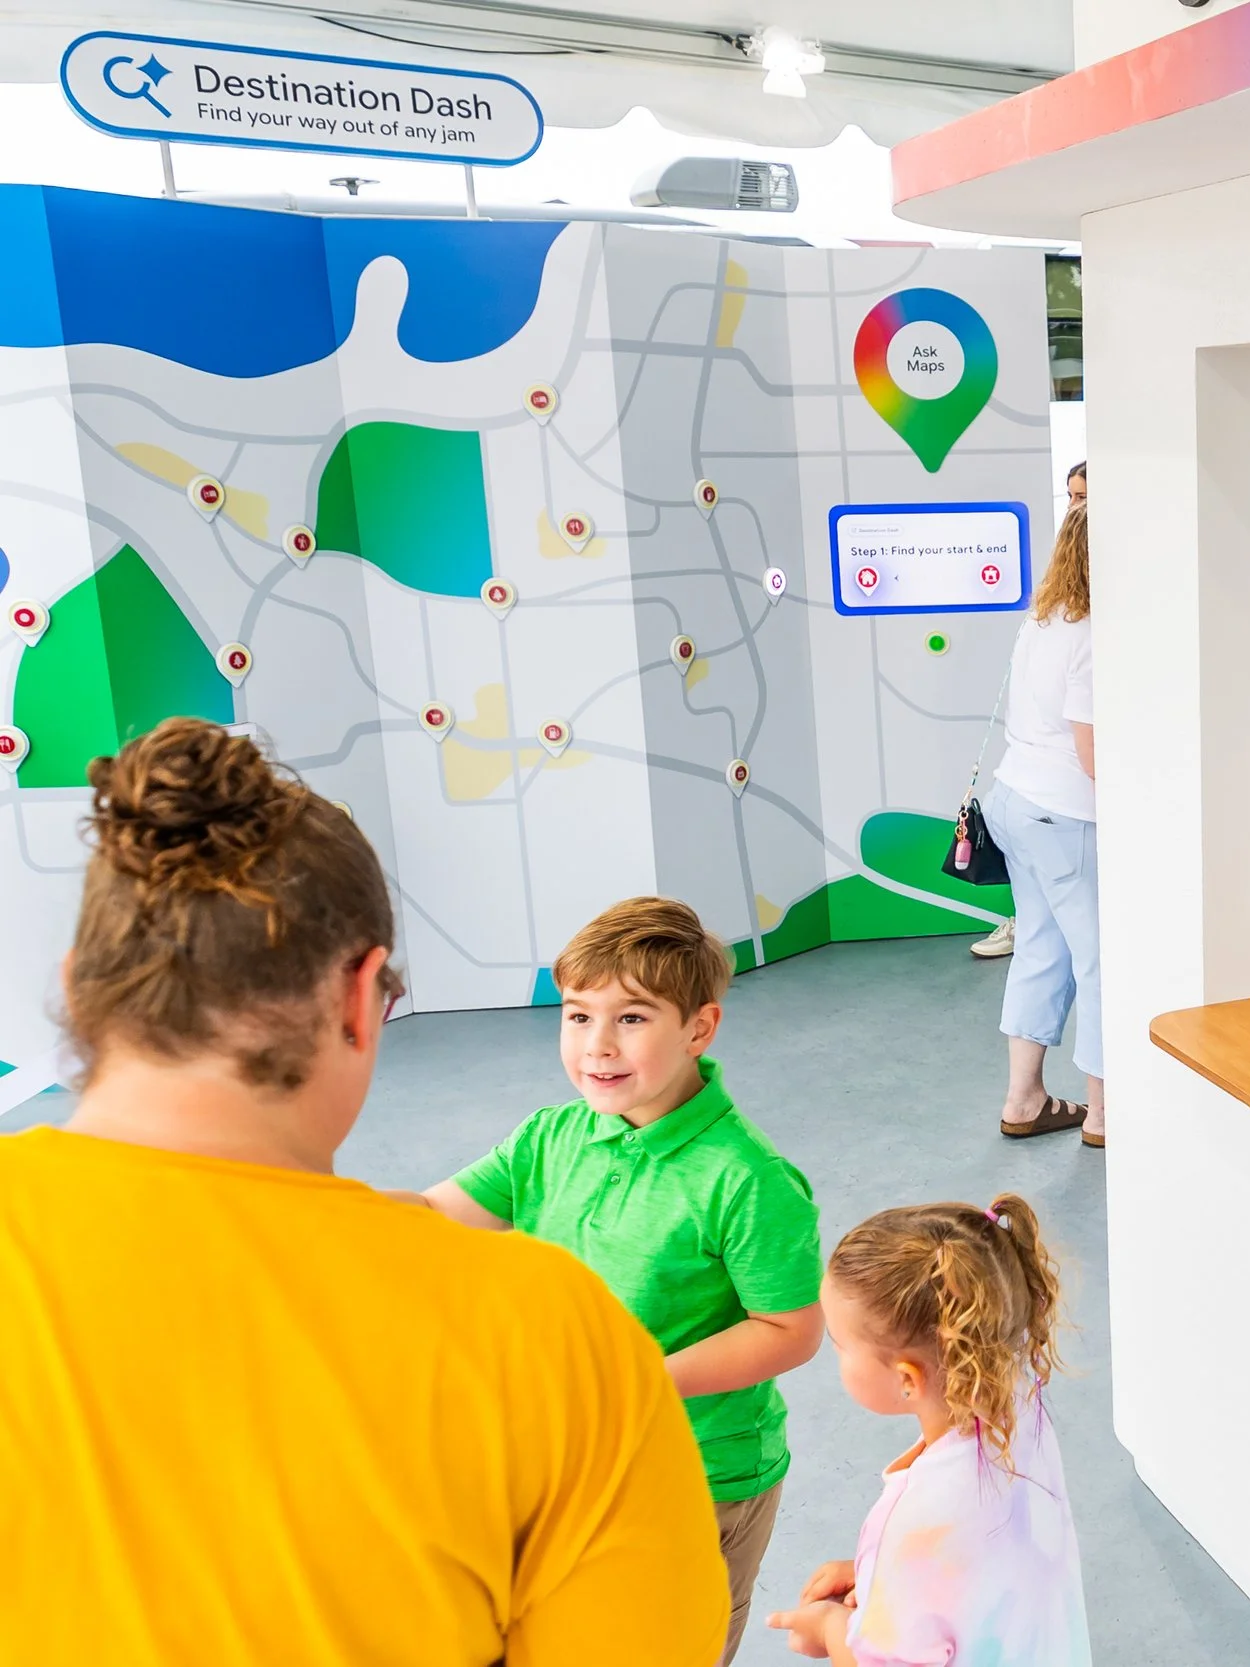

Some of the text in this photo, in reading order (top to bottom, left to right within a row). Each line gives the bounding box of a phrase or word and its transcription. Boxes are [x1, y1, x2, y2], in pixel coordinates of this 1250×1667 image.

[194, 64, 492, 120] Destination Dash
[198, 102, 475, 144] Find your way out of any jam
[913, 346, 938, 357] Ask
[907, 360, 945, 374] Maps
[851, 544, 1007, 557] Step 1: Find your start & end
